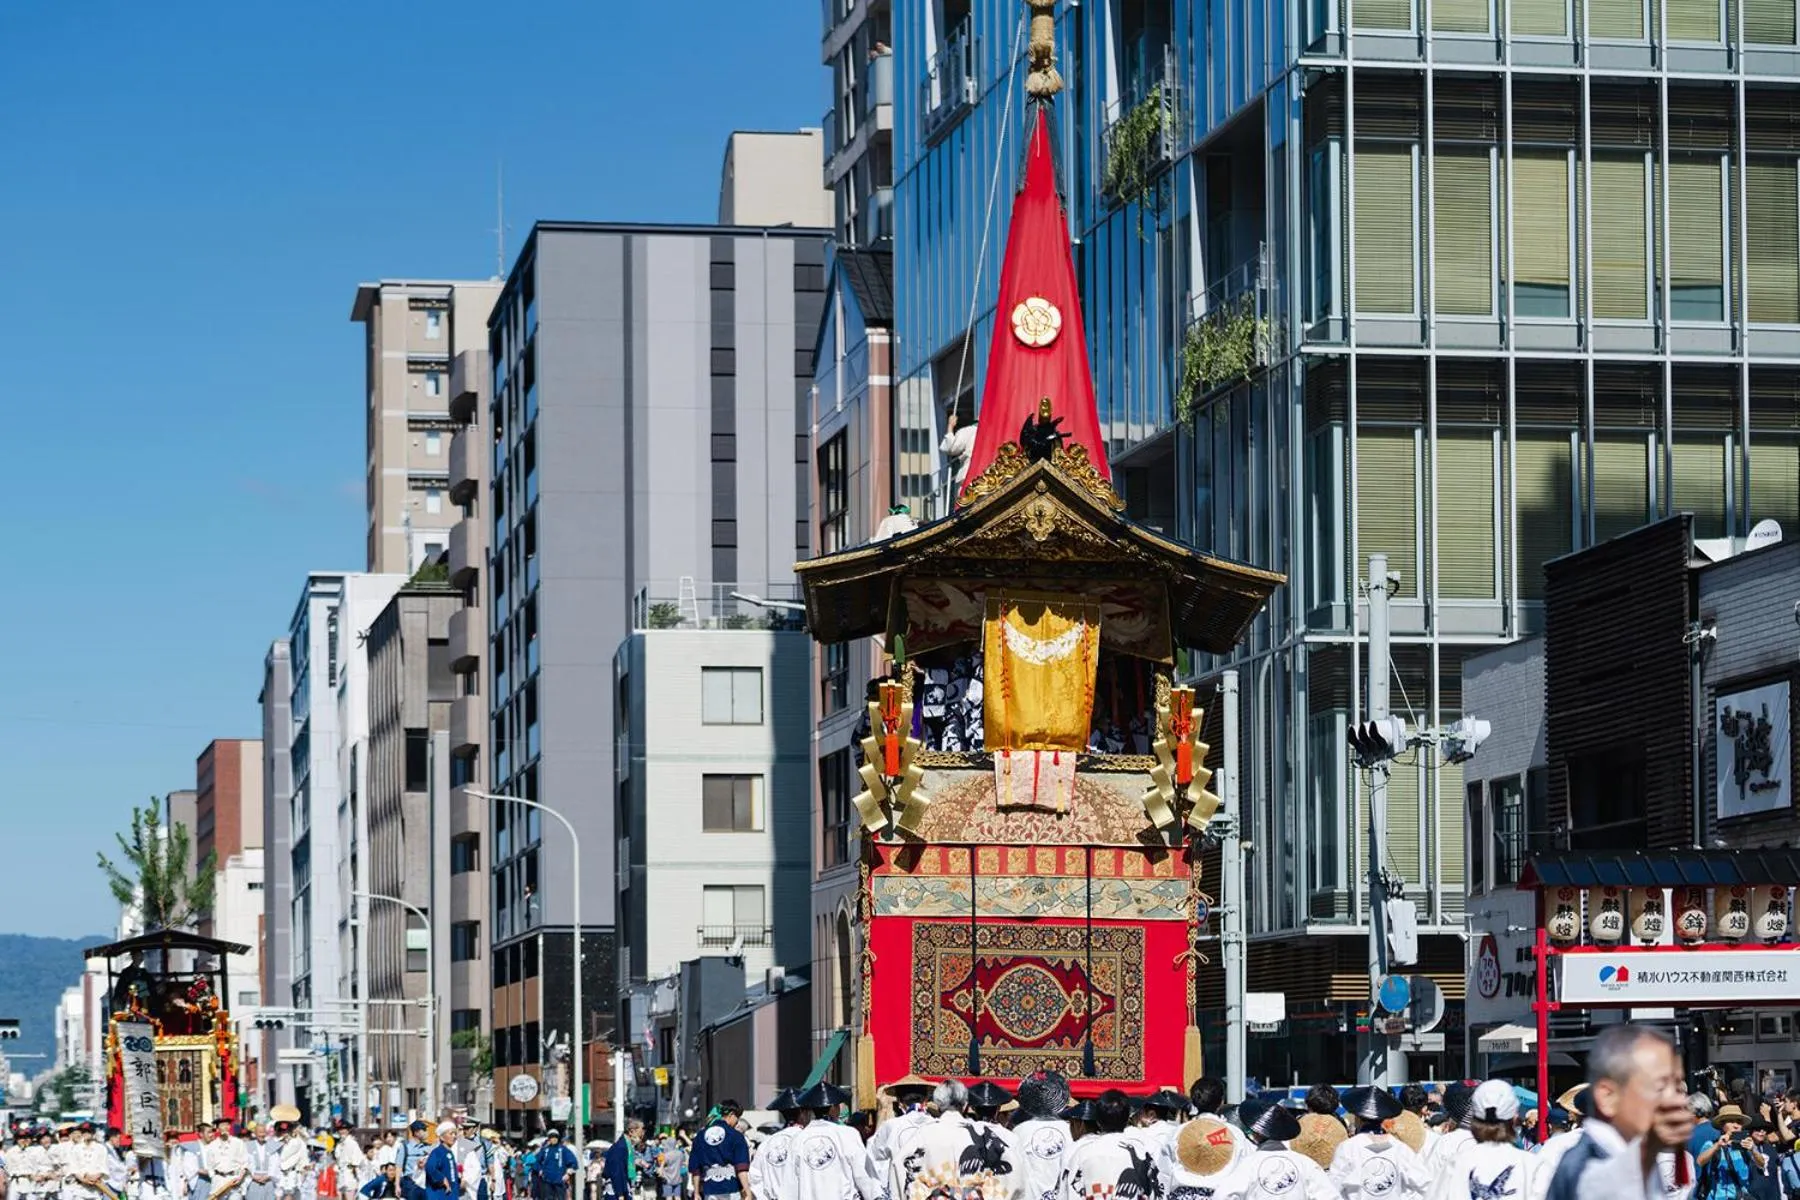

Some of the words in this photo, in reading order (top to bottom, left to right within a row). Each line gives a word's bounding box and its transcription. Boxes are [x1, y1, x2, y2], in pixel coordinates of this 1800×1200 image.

[1637, 970, 1787, 984] 積水ハウス不動産関西株式会社
[130, 1056, 159, 1138] 郭巨山
